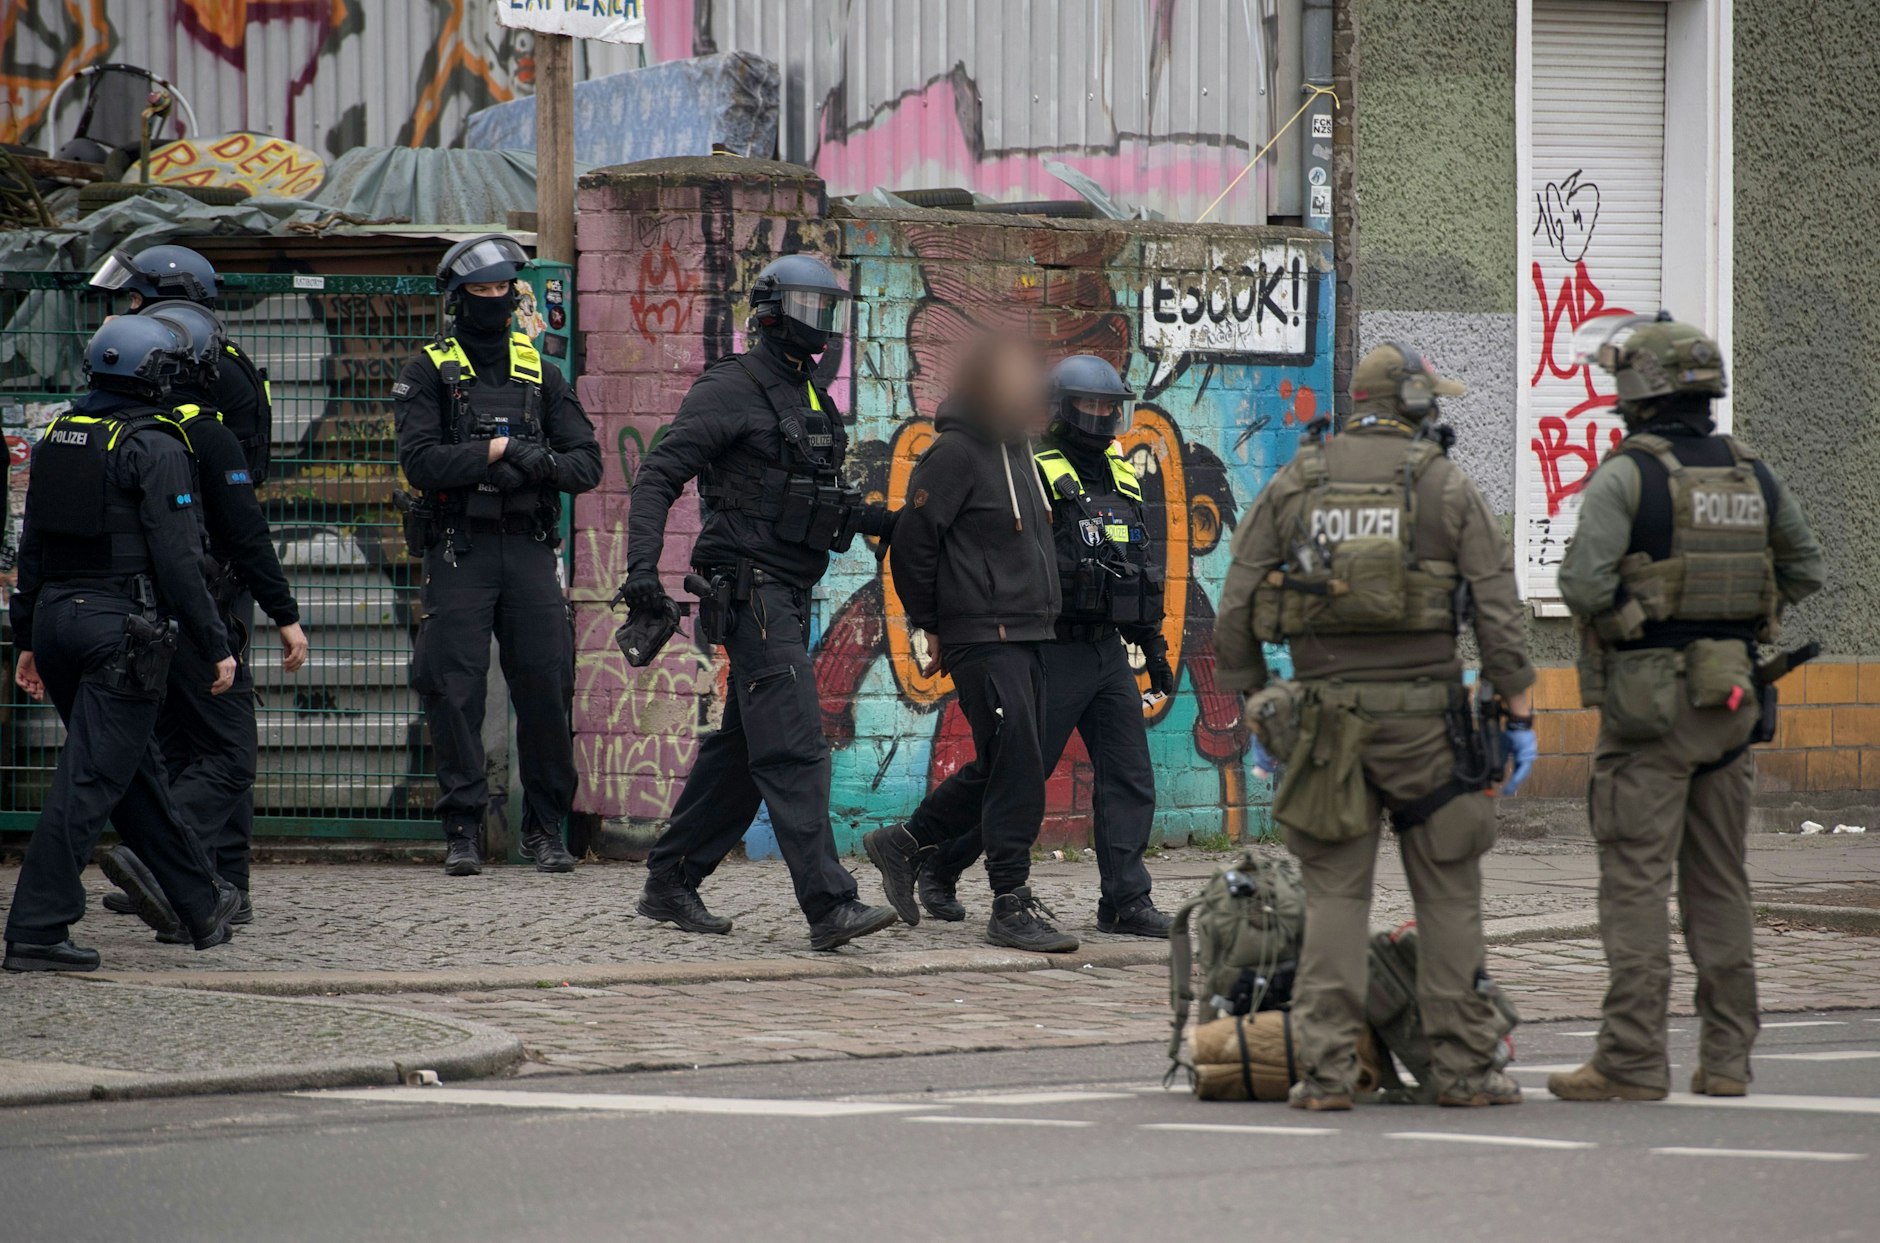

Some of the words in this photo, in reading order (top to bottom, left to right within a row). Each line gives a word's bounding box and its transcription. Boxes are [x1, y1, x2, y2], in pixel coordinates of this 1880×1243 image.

[1313, 118, 1332, 126] FCK
[1313, 126, 1332, 134] NZS
[211, 134, 318, 195] DEMO
[51, 430, 88, 446] POLIZEI
[1693, 492, 1764, 526] POLIZE
[1311, 508, 1400, 542] POLIZEI
